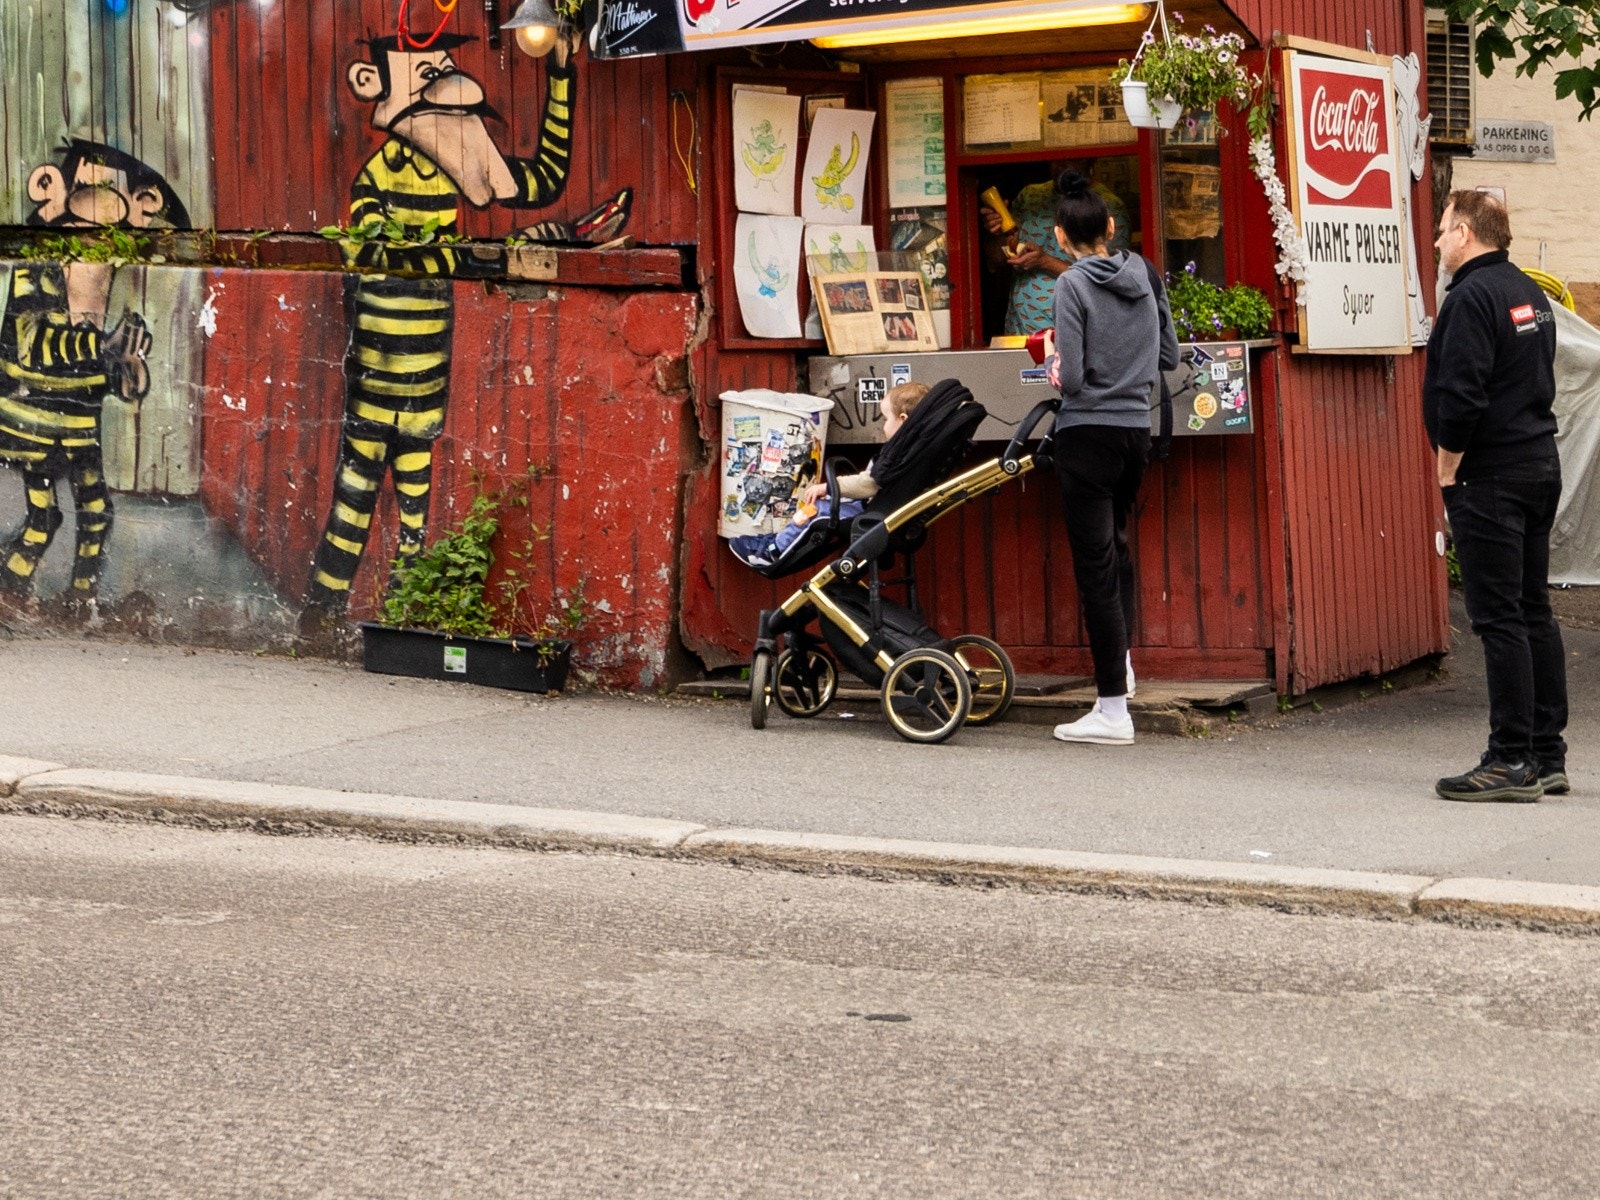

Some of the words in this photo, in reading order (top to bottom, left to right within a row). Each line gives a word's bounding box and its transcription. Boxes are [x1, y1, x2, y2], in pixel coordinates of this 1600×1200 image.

[1483, 126, 1548, 141] PARKERING
[1305, 221, 1351, 263] VARME
[1355, 223, 1401, 264] PØLSER
[1343, 284, 1375, 326] Syver
[861, 390, 885, 401] CREW
